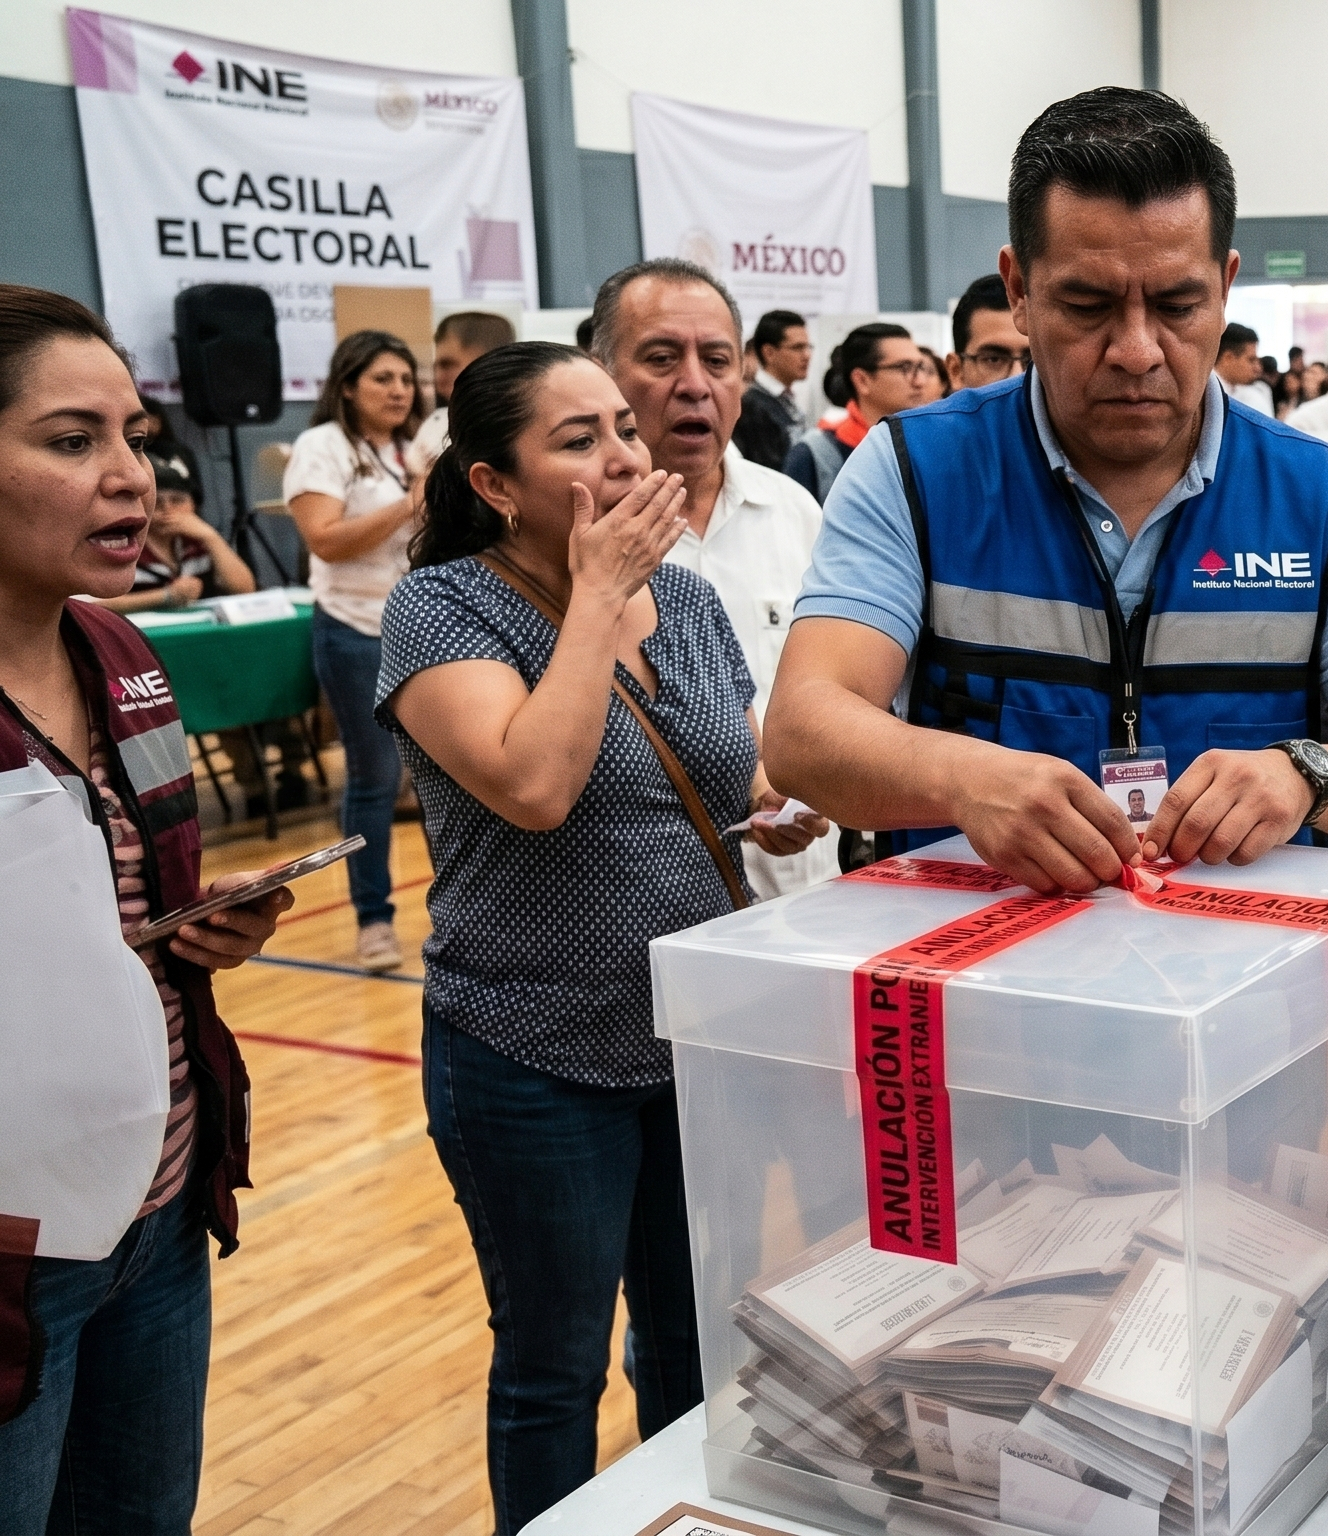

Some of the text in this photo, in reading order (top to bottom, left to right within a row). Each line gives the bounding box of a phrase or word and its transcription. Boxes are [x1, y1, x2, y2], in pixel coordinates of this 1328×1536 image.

[217, 59, 308, 102] INE
[197, 168, 393, 220] CASILLA
[156, 218, 431, 270] ELECTORAL
[731, 234, 847, 277] MÉXICO
[1233, 579, 1273, 589] Nacional
[1234, 552, 1312, 577] INE
[118, 669, 169, 699] INE
[866, 964, 914, 1245] ANULACIÓN PO
[909, 968, 942, 1251] INTERVENCIÓN EXTRANJE
